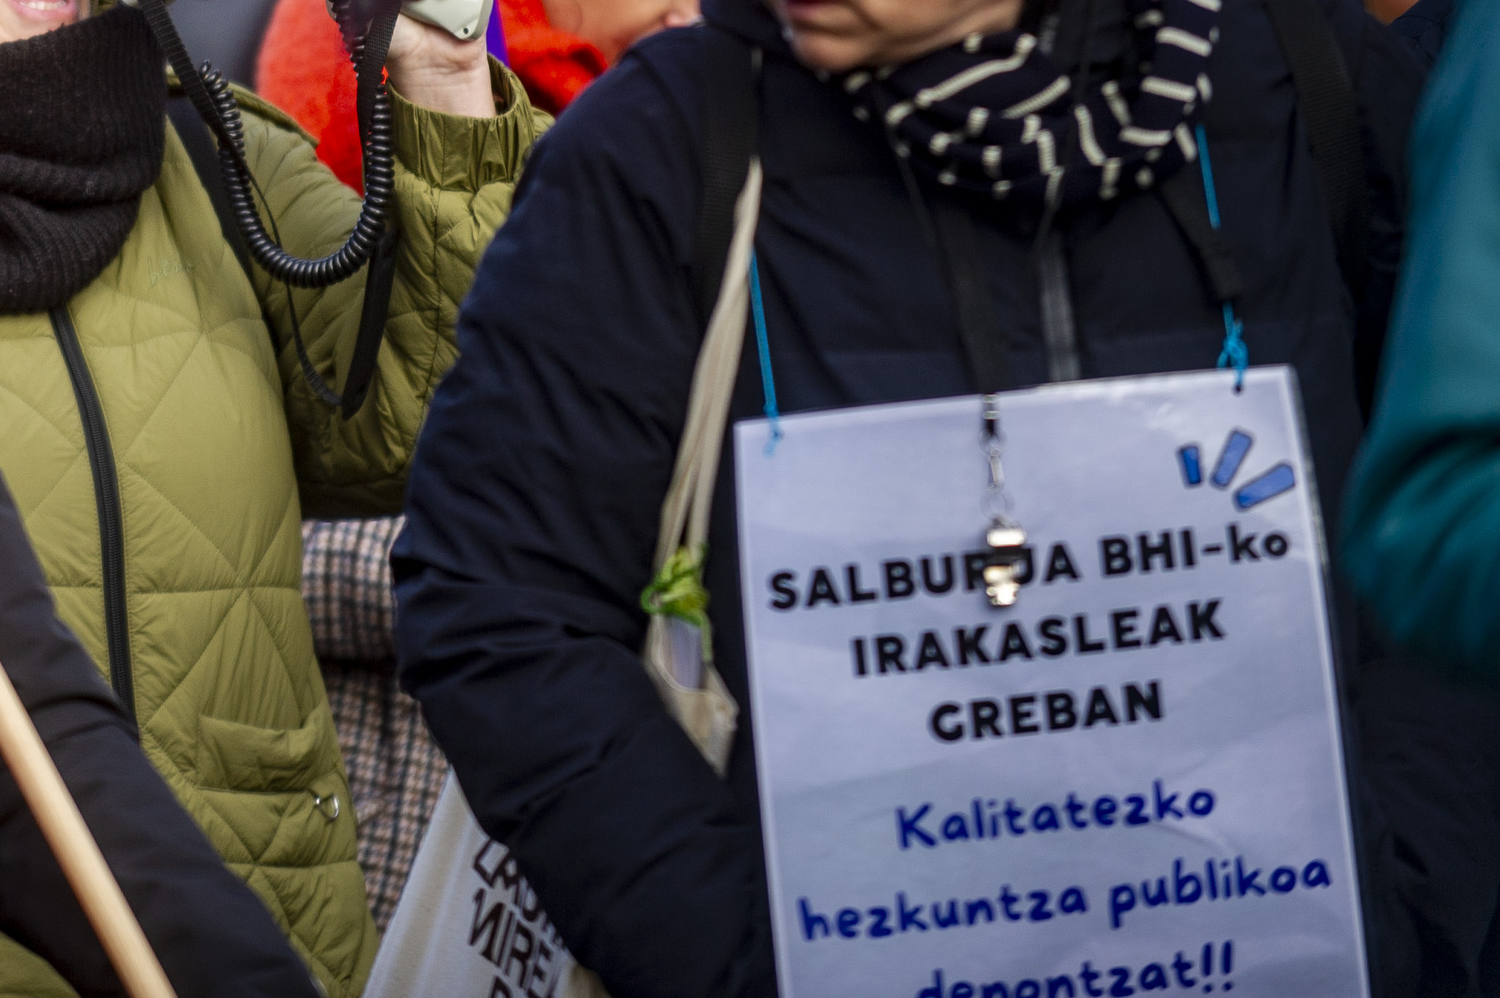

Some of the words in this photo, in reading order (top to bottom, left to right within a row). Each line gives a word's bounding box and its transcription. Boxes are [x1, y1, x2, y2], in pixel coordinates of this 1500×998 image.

[1100, 524, 1290, 576] BHI-ko
[852, 600, 1225, 678] IRAKASLEAK
[929, 680, 1165, 743] GREBAN
[896, 779, 1217, 851] Kalitatezko
[800, 886, 1089, 942] hezkuntza
[1110, 855, 1332, 929] publikoa
